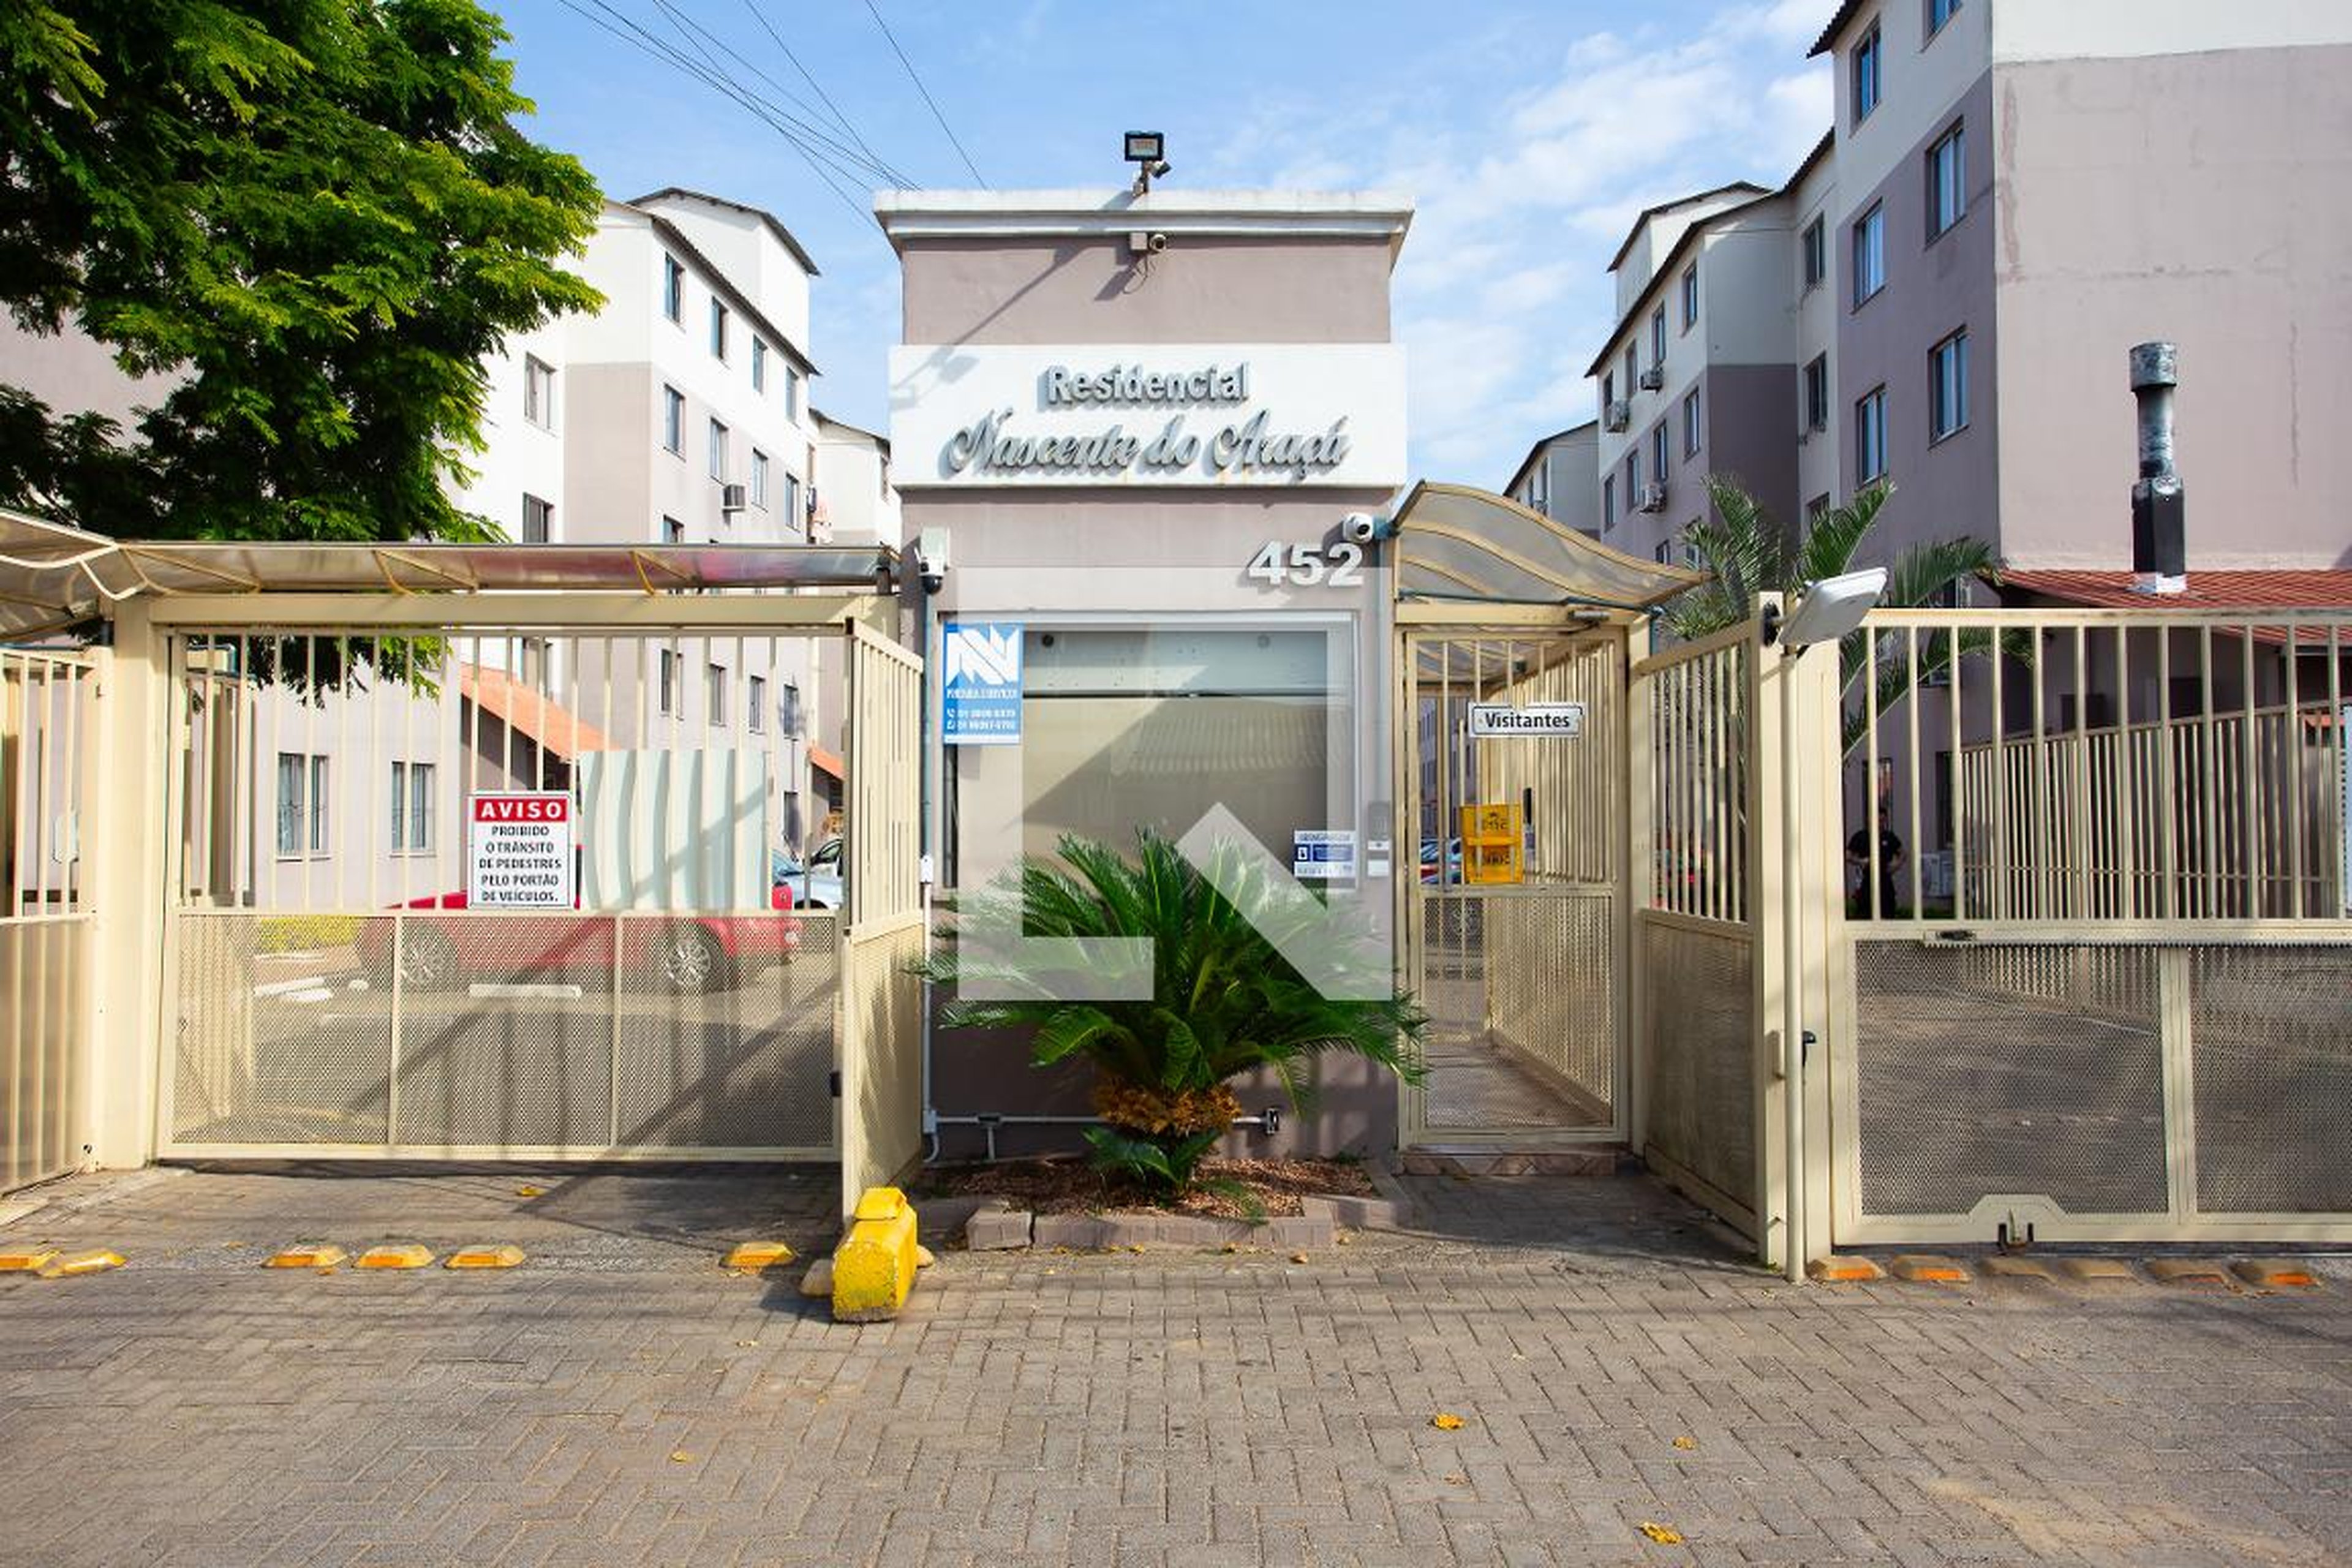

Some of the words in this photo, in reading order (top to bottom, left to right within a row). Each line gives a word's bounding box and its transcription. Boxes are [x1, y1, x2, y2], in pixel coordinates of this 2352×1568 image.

[1046, 361, 1250, 404] Residencial
[946, 407, 1140, 473] Nascente
[1141, 414, 1201, 468] do
[1247, 540, 1364, 587] 452
[1485, 711, 1570, 728] Visitantes
[481, 801, 562, 818] AVISO
[491, 826, 550, 836] PROIBIDO
[485, 842, 495, 854] O
[479, 859, 494, 869] DE
[496, 859, 562, 869] PEDESTRES
[481, 875, 510, 886] PELO
[513, 873, 559, 886] PORTÃO
[481, 891, 496, 902] DE
[499, 889, 559, 902] VEÍCULOS.
